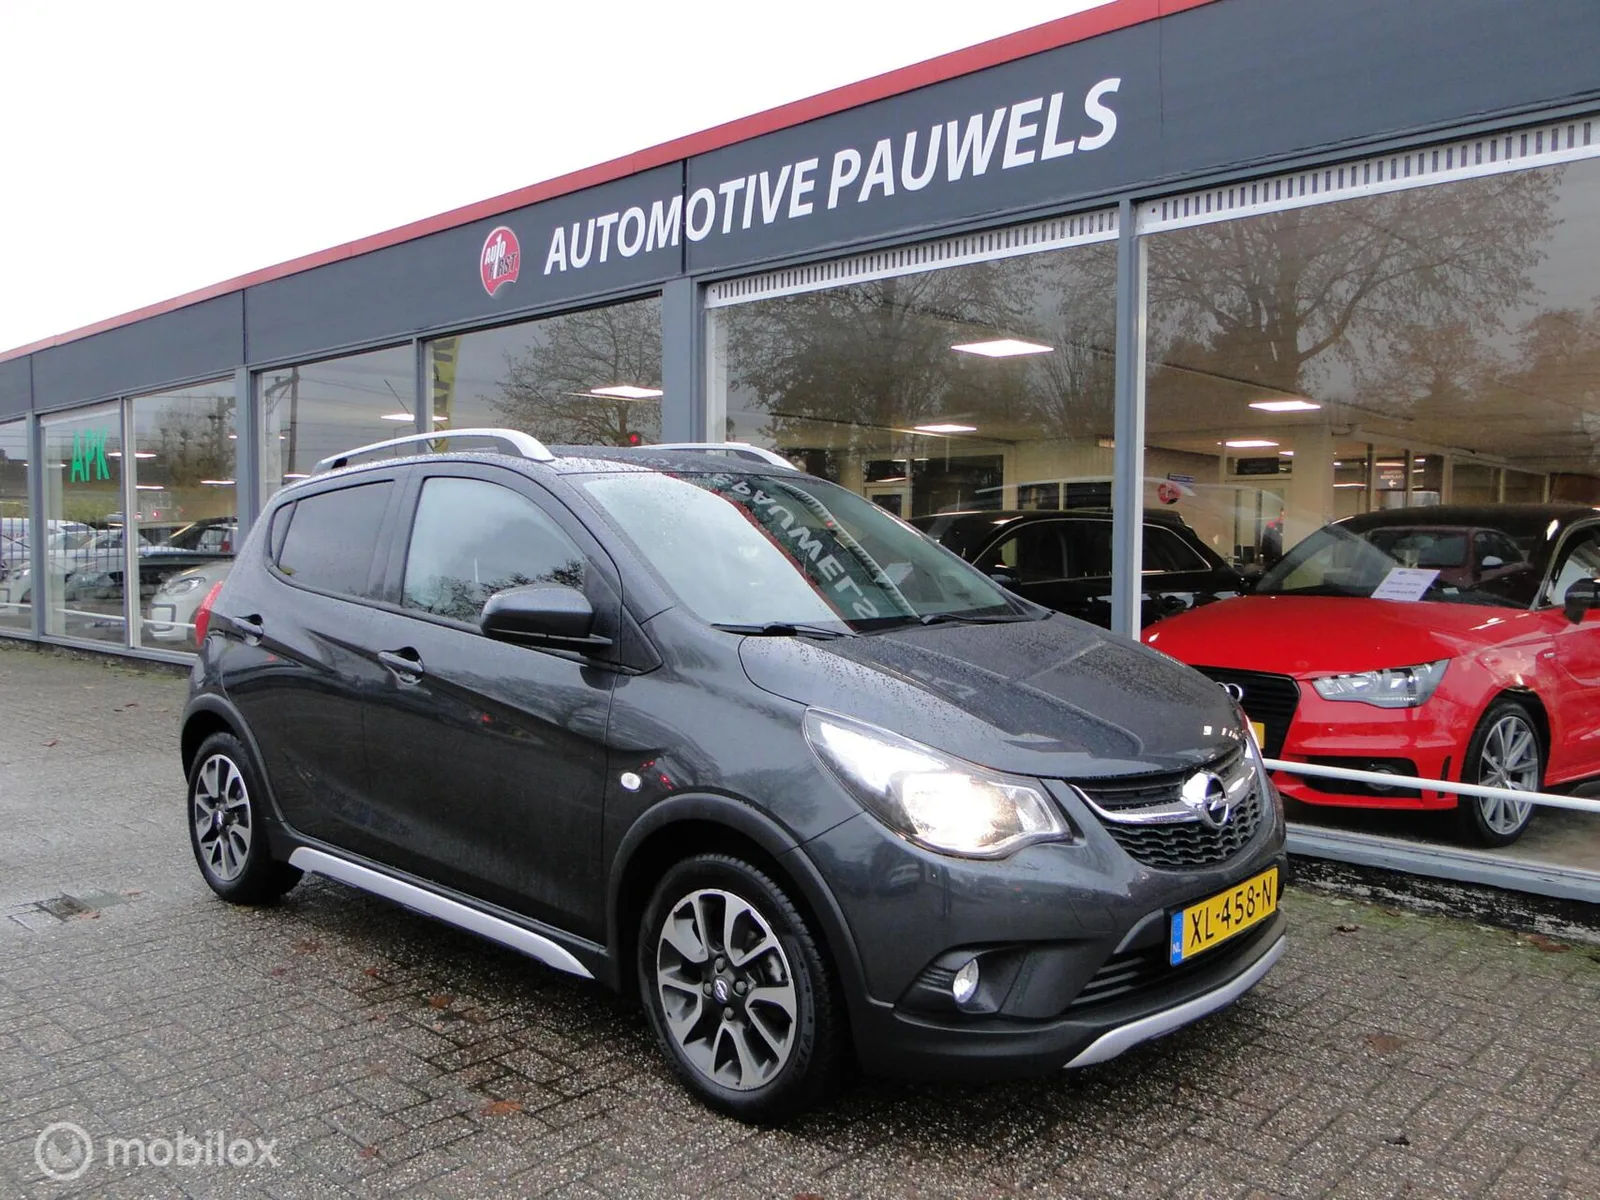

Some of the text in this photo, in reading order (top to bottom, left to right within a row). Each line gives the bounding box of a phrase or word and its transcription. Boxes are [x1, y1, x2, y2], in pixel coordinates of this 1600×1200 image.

[543, 77, 1121, 276] AUTOMOTIVE PAUWELS
[71, 425, 110, 483] APK
[1190, 876, 1272, 948] XL-458-N
[1172, 941, 1182, 953] NL
